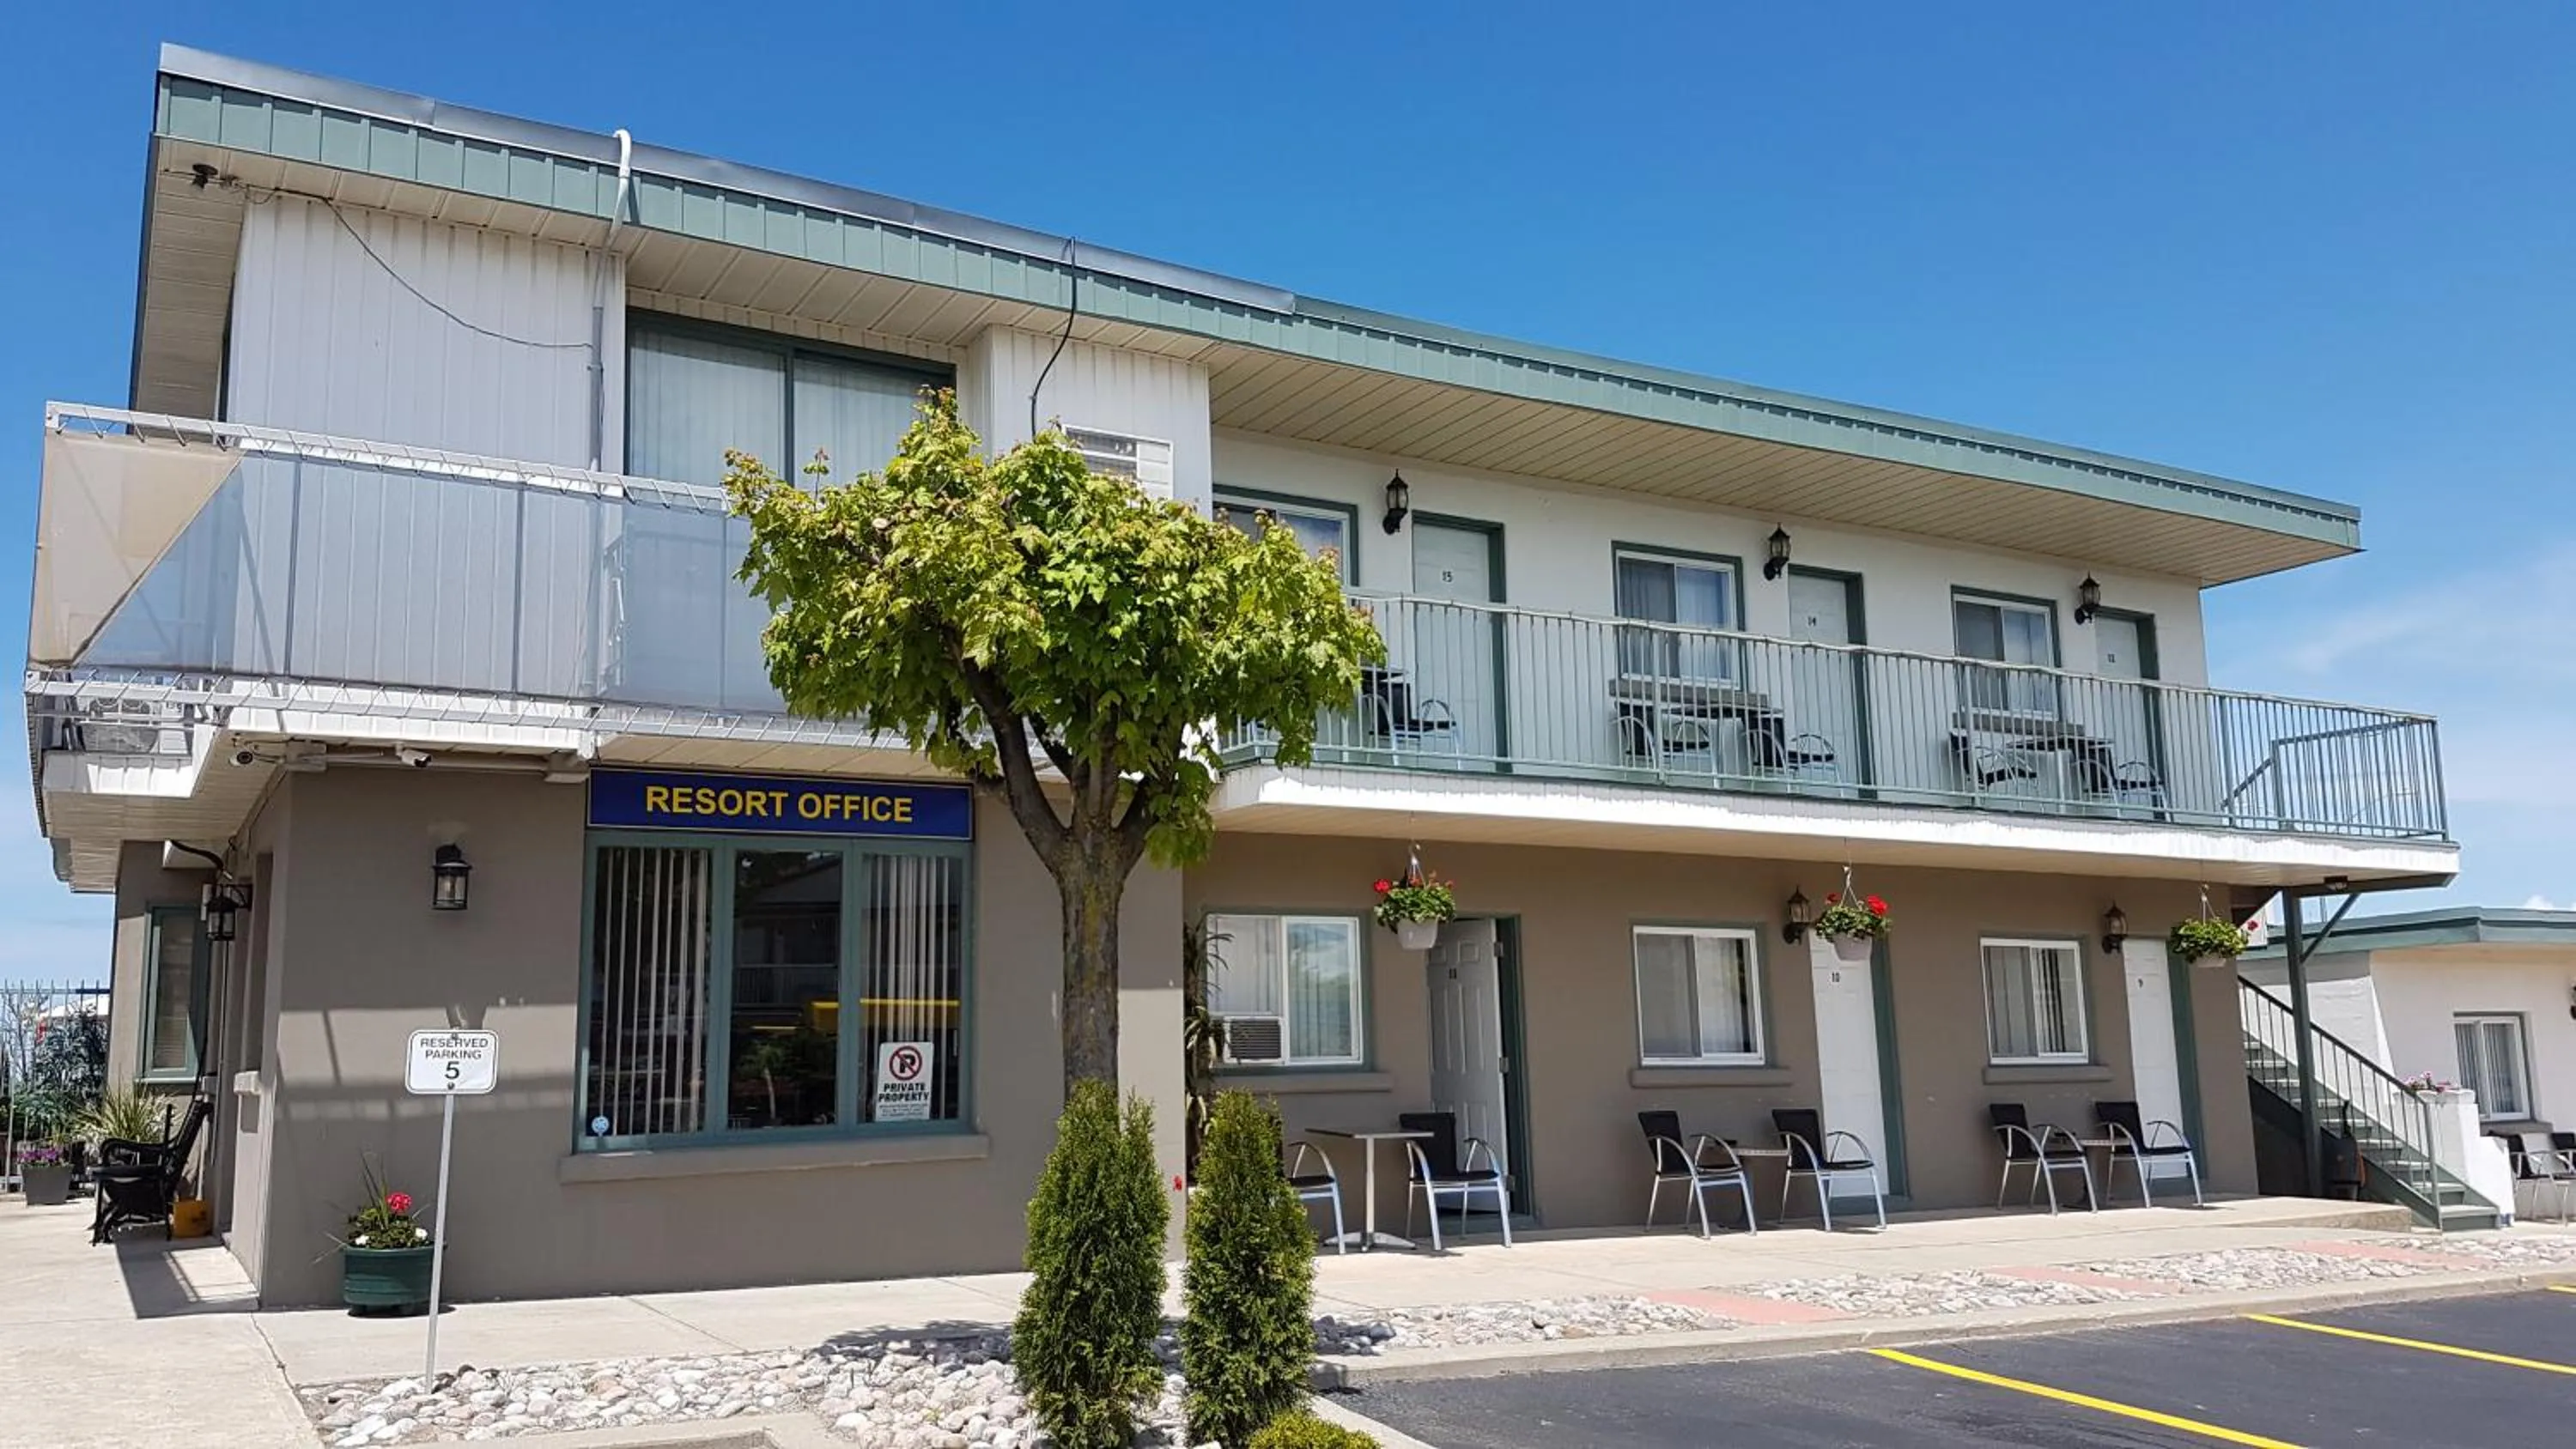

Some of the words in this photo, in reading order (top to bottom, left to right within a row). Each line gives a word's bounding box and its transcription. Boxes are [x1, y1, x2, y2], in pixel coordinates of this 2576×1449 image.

[646, 785, 789, 817] RESORT
[798, 792, 913, 822] OFFICE
[420, 1038, 489, 1048] RESERVED
[425, 1049, 482, 1059] PARKING
[444, 1061, 460, 1080] 5
[884, 1082, 926, 1093] PRIVATE
[878, 1091, 930, 1103] PROPERTY
